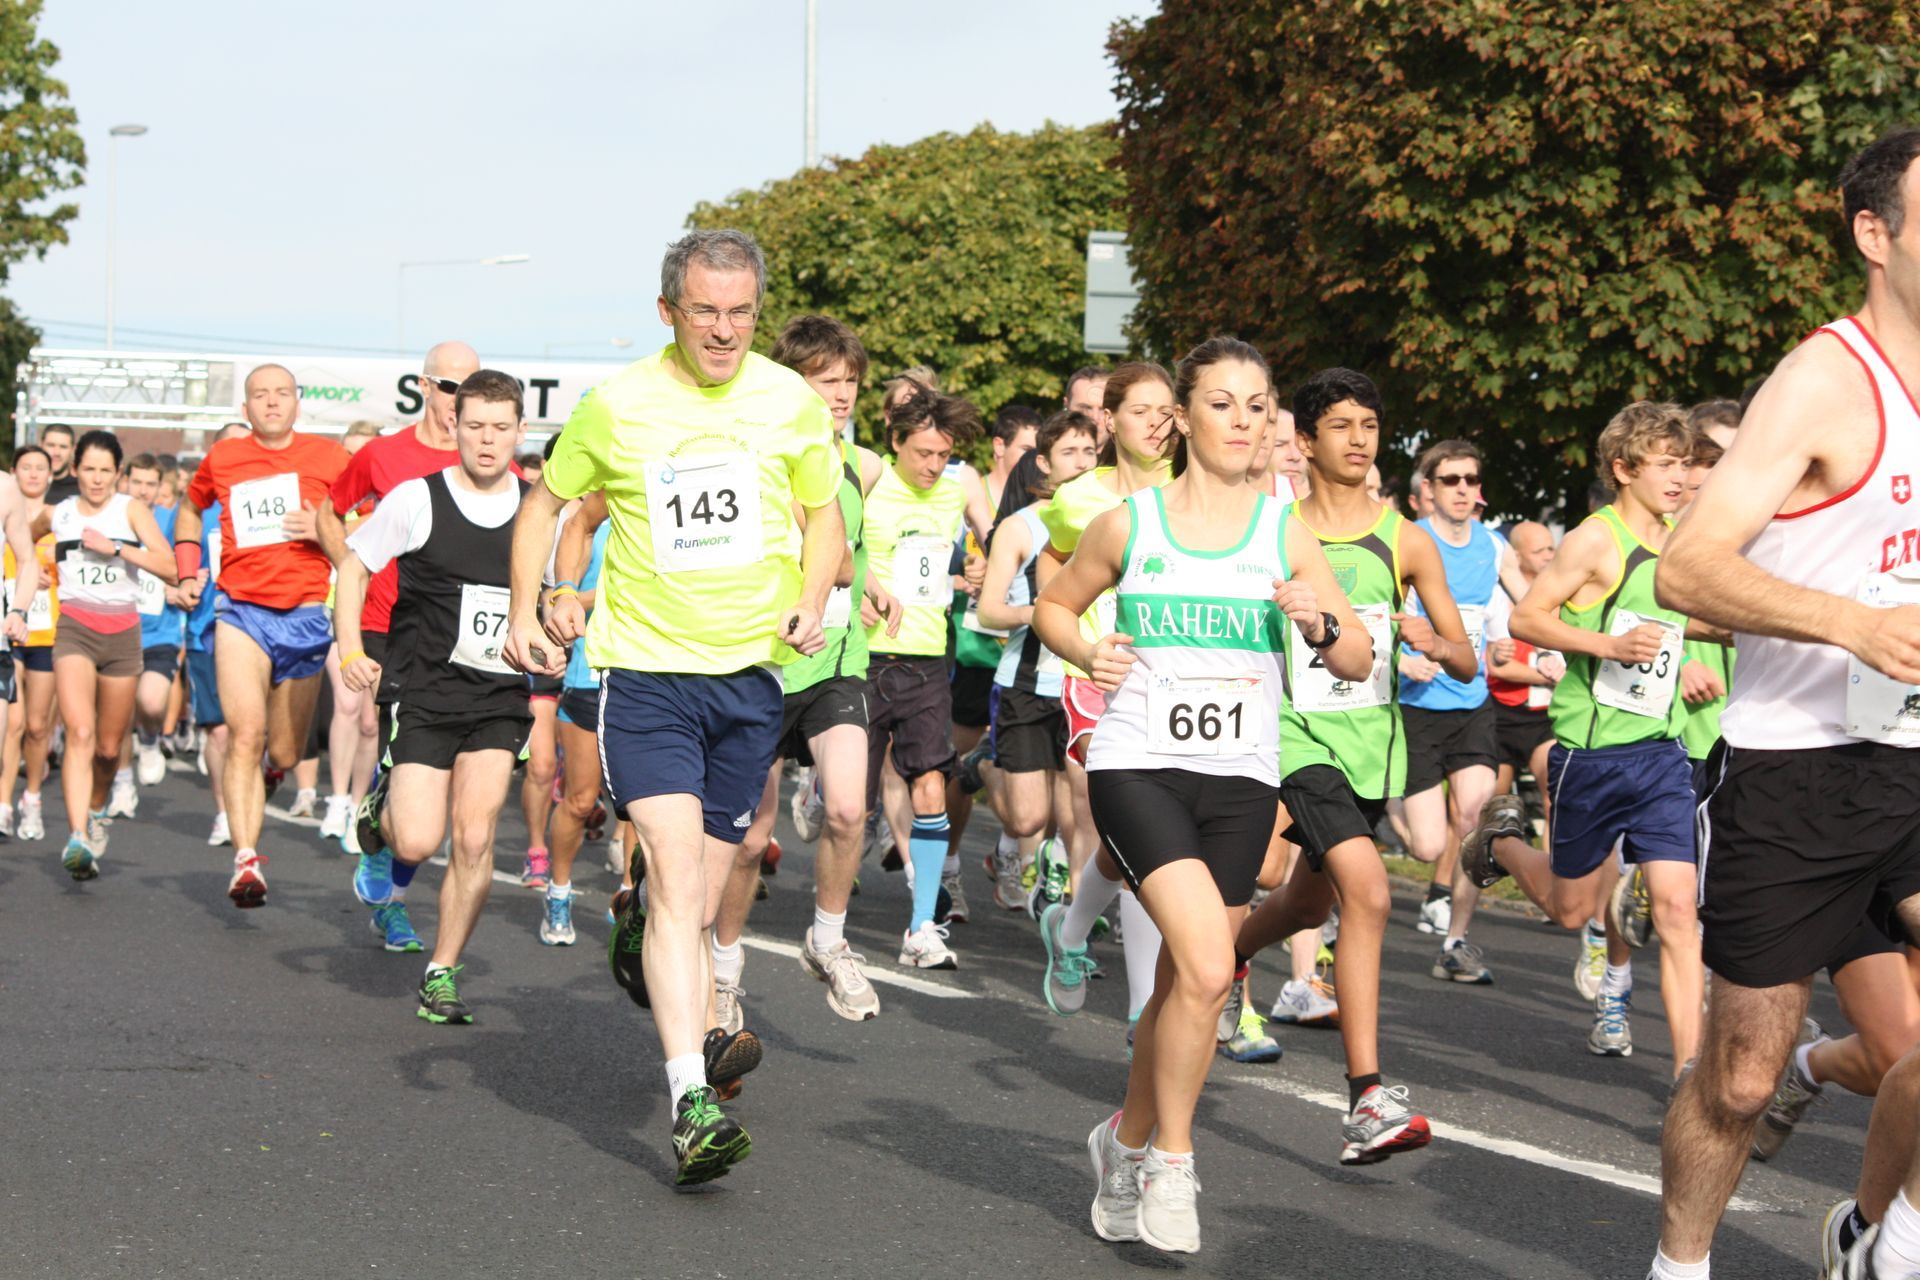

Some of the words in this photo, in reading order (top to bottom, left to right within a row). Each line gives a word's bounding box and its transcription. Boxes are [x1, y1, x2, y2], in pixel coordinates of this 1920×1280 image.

[243, 496, 286, 520] 148
[666, 488, 740, 528] 143
[674, 535, 732, 550] Runworx
[77, 565, 117, 585] 126
[919, 556, 930, 578] 8
[473, 610, 509, 638] 67
[1136, 602, 1271, 643] RAHENY
[1169, 702, 1243, 741] 661
